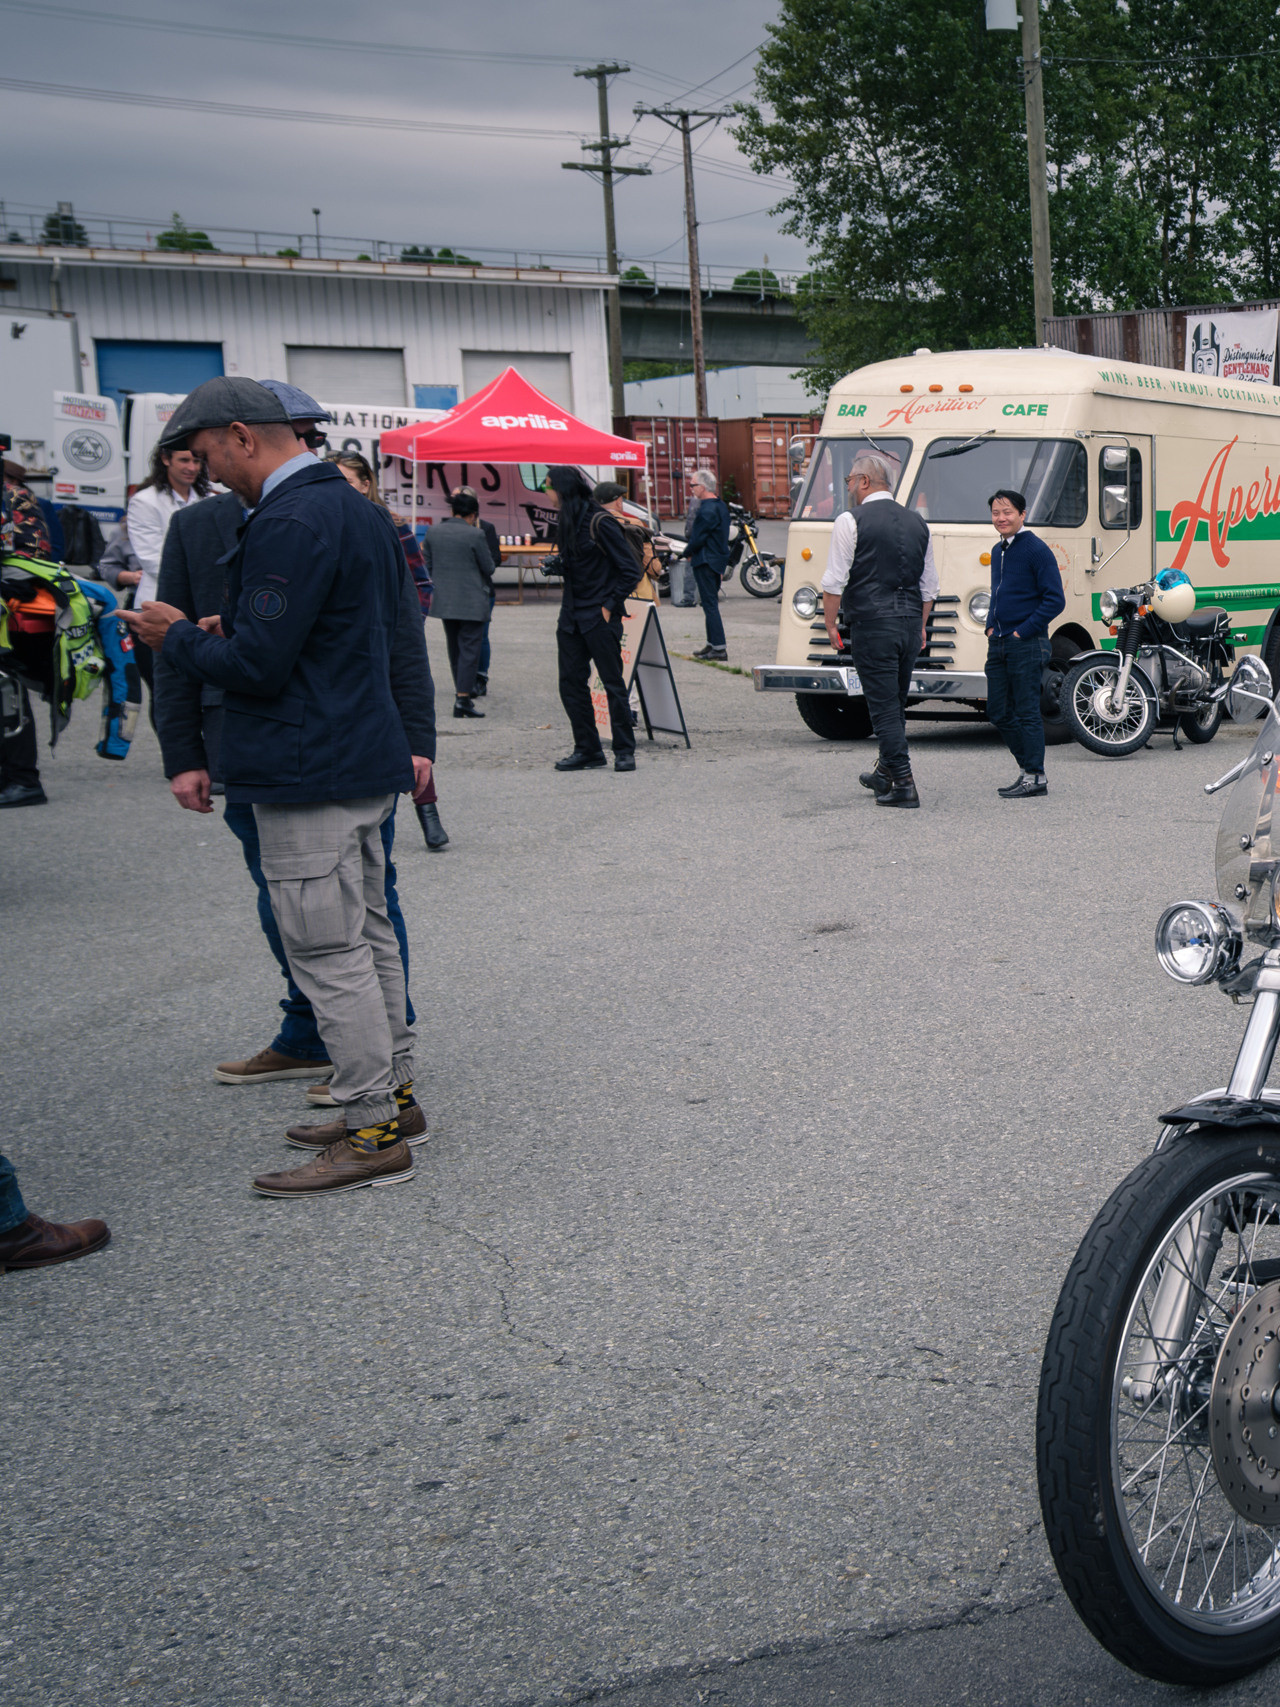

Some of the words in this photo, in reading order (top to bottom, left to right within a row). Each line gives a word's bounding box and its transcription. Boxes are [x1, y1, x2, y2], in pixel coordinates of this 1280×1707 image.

[1223, 347, 1275, 364] Distinguished
[63, 404, 106, 420] RENTALS
[837, 404, 867, 417] BAR
[878, 394, 987, 428] Aperitivo!
[1002, 404, 1048, 416] CAFE
[481, 414, 568, 430] aprilia
[610, 452, 638, 461] aprilia
